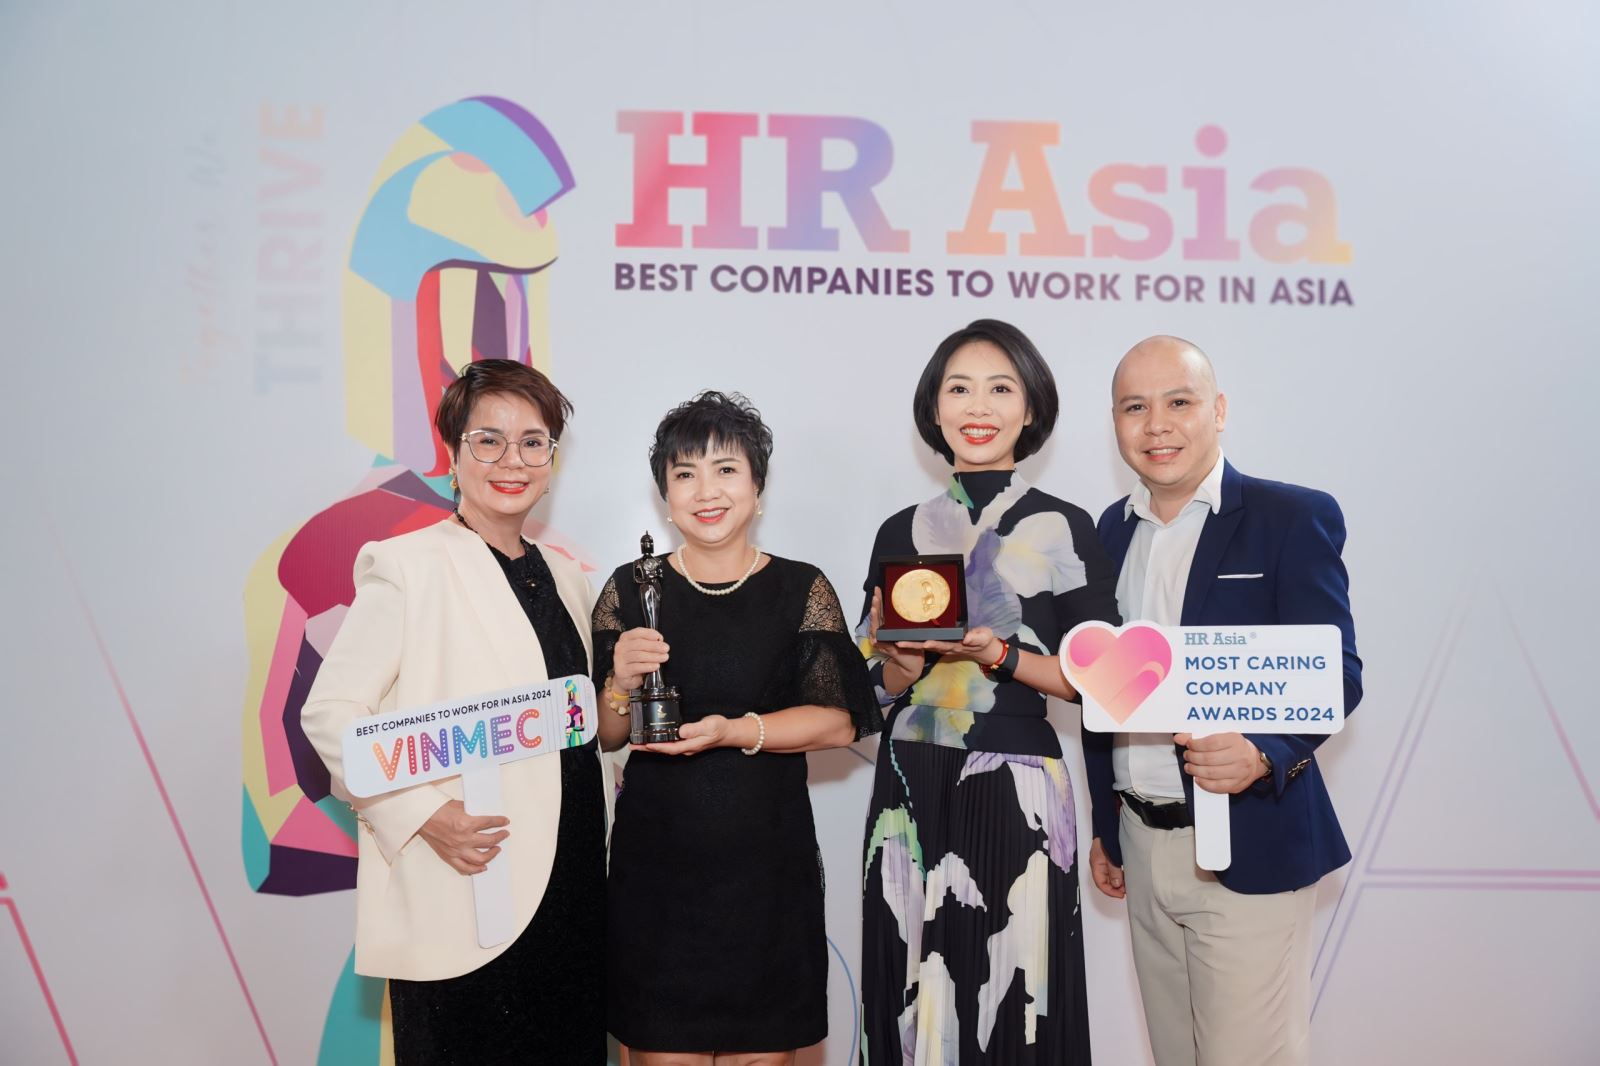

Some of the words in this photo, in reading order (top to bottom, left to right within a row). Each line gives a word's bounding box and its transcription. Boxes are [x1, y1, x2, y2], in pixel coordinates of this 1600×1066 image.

[615, 110, 911, 253] HR
[946, 120, 1353, 264] Asia
[253, 97, 325, 396] THRIVE
[614, 263, 698, 291] BEST
[710, 264, 935, 296] COMPANIES
[947, 270, 994, 298] TO
[1008, 271, 1121, 301] WORK
[1135, 275, 1205, 303] FOR
[1220, 276, 1255, 303] IN
[1269, 278, 1355, 306] ASIA
[1184, 632, 1209, 646] HR
[1213, 632, 1247, 646] Asia
[1185, 656, 1240, 670] MOST
[1247, 656, 1326, 670] CARING
[1186, 681, 1287, 696] COMPANY
[356, 723, 380, 737] BEST
[381, 712, 436, 731] COMPANIES
[438, 709, 451, 719] TO
[451, 704, 480, 717] WORK
[481, 699, 499, 711] FOR
[501, 697, 510, 706] IN
[512, 694, 531, 705] ASIA
[532, 689, 552, 701] 2024
[1187, 707, 1277, 721] AWARDS
[1284, 707, 1335, 721] 2024
[372, 708, 543, 782] VINMEC
